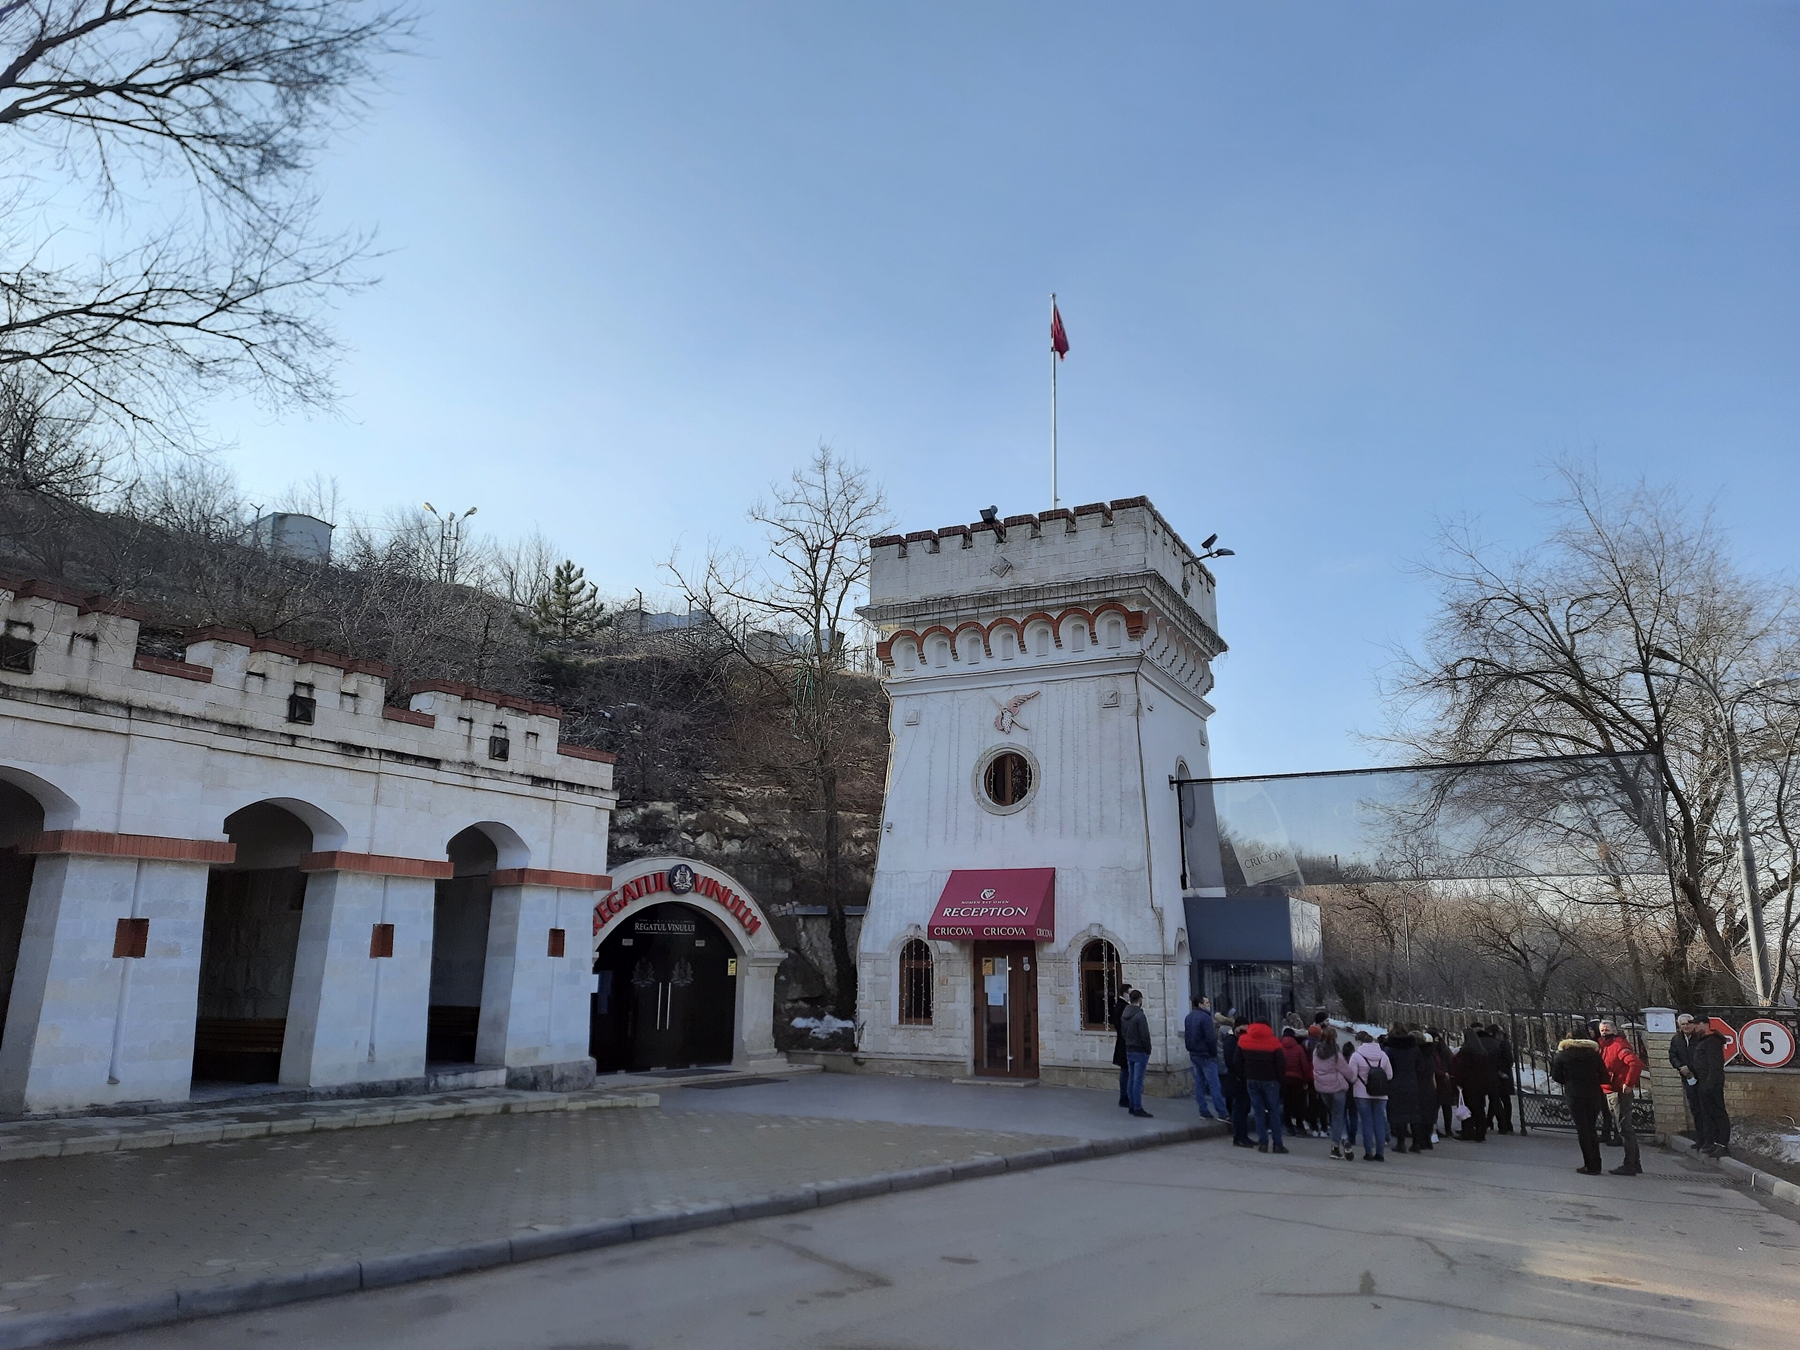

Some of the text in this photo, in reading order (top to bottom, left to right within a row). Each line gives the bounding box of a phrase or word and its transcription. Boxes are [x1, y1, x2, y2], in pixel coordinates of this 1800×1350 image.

[1244, 851, 1287, 869] CRICOV
[693, 873, 762, 935] VINULUI
[943, 907, 1028, 916] RECEPTION
[634, 922, 696, 932] REGATUL VINULUI
[934, 927, 1026, 936] CRICOVA CRICOVA
[1760, 1032, 1774, 1054] 5
